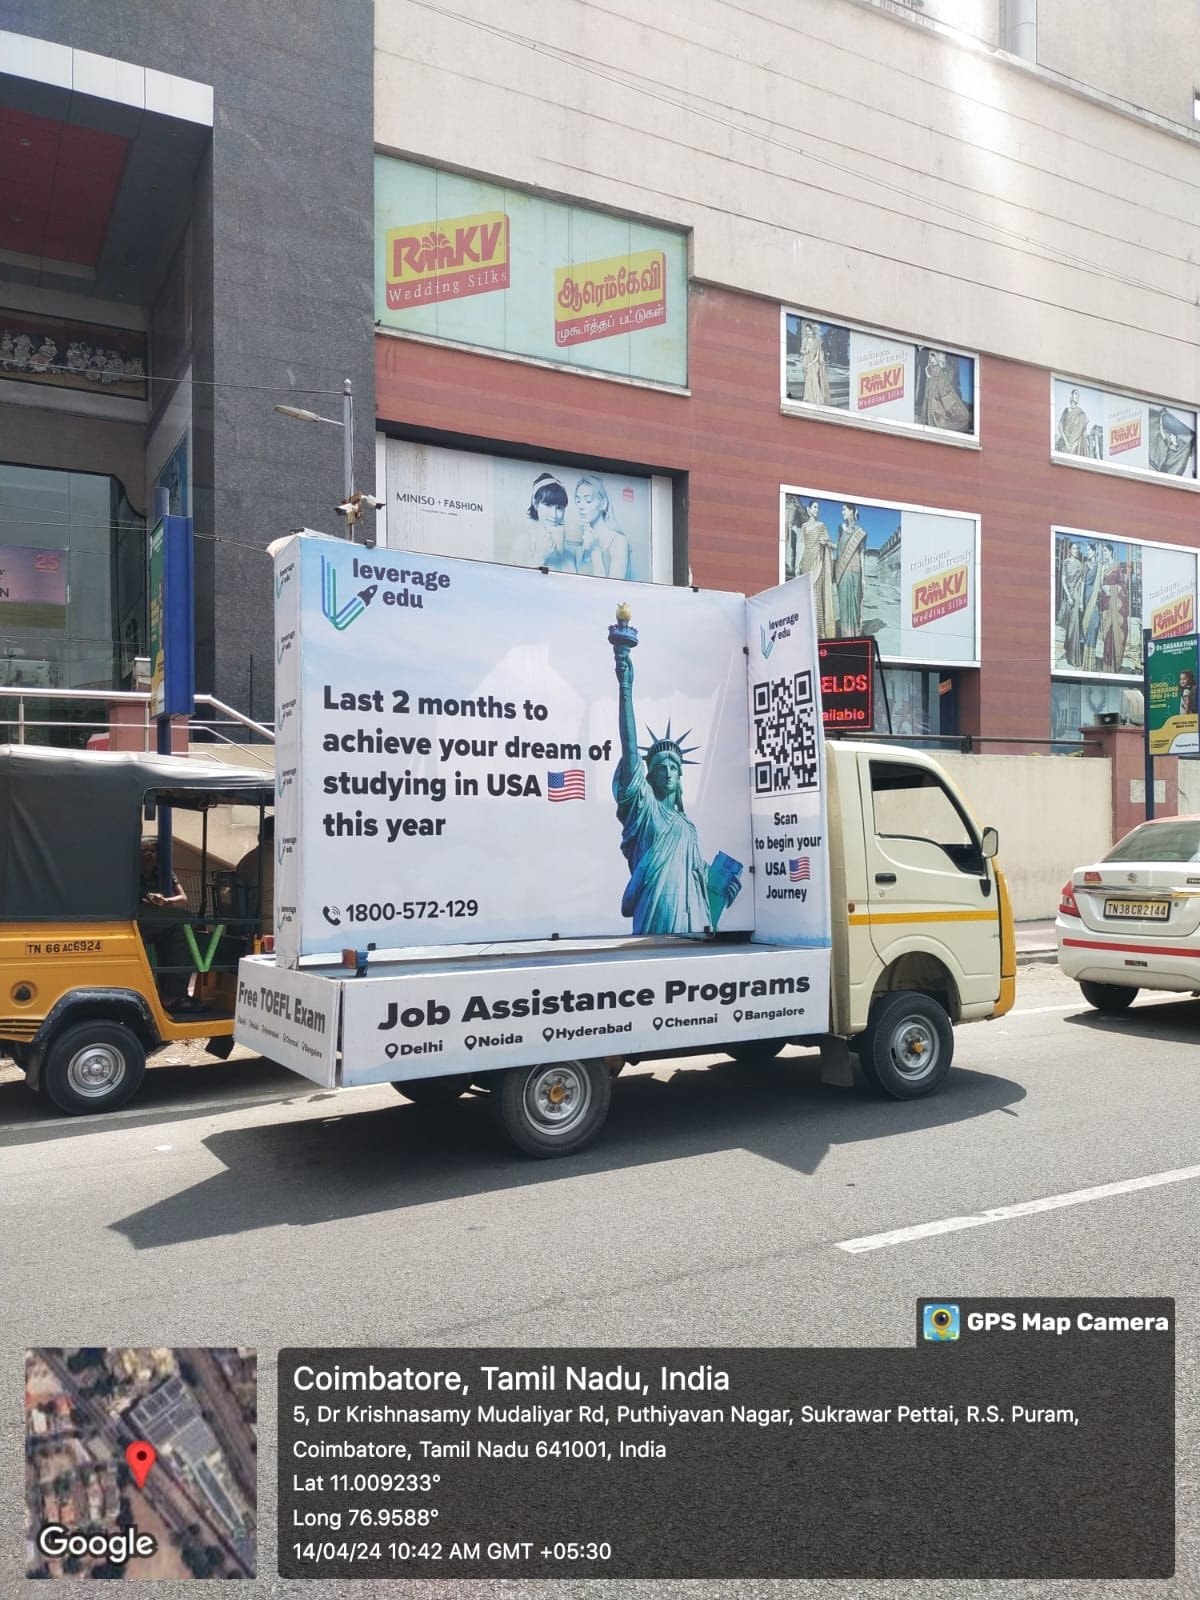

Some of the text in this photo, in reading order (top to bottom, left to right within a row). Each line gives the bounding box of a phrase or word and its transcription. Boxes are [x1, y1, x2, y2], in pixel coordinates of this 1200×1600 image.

[388, 271, 507, 303] Wedding Silks
[557, 260, 662, 313] ஆரெம்கேவி
[619, 303, 665, 324] பட்டுகள்
[396, 491, 436, 506] MINISO
[443, 499, 484, 513] FASHION
[34, 553, 60, 570] 25
[911, 550, 951, 572] traditions
[925, 548, 973, 575] made trendy
[353, 557, 451, 592] leverage
[382, 587, 424, 609] edu
[769, 611, 800, 631] leverage
[913, 597, 967, 625] Wedding Silks
[777, 627, 792, 640] edu
[821, 674, 868, 693] ELDS
[323, 685, 549, 721] Last 2 months to
[822, 708, 865, 722] ailable
[323, 728, 612, 762] achieve your dream of
[323, 770, 543, 801] studying in USA
[323, 810, 446, 842] this year
[774, 812, 798, 825] Scan
[755, 836, 822, 851] to begin your
[765, 862, 787, 876] USA
[766, 885, 807, 902] Journey
[345, 899, 479, 922] 1800-572-129
[1107, 903, 1166, 916] TN38CR2144
[27, 944, 41, 953] TN
[46, 944, 60, 953] 66
[239, 981, 326, 1034] Free TOEFL Exam
[378, 976, 810, 1030] Job Assistance Programs
[400, 1006, 805, 1056] Delhi Noida Hyderabad Chennai Bangalore
